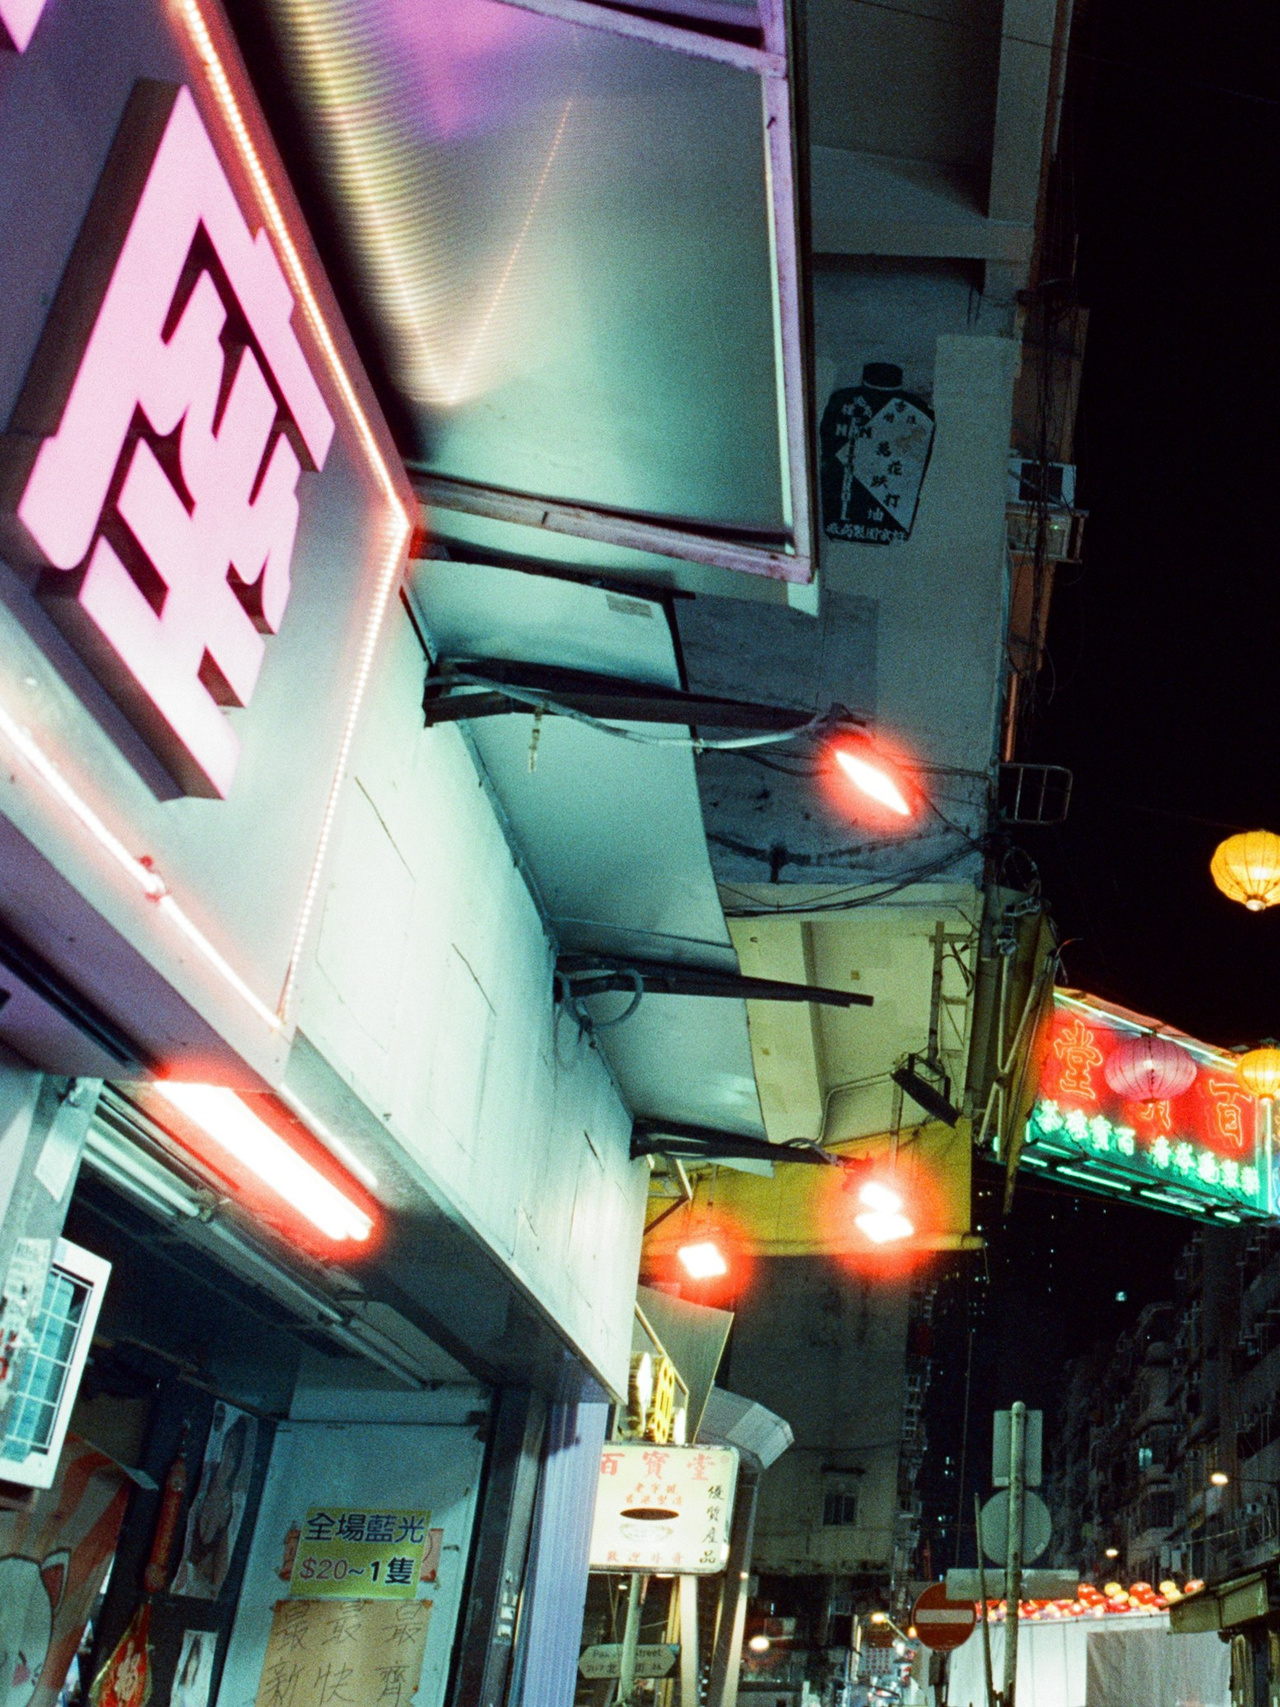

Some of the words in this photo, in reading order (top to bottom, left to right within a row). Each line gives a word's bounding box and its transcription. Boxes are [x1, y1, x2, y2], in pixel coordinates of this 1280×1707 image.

[18, 85, 336, 799] 座
[600, 1450, 716, 1481] 百寶堂
[304, 1512, 426, 1546] 全場藍光
